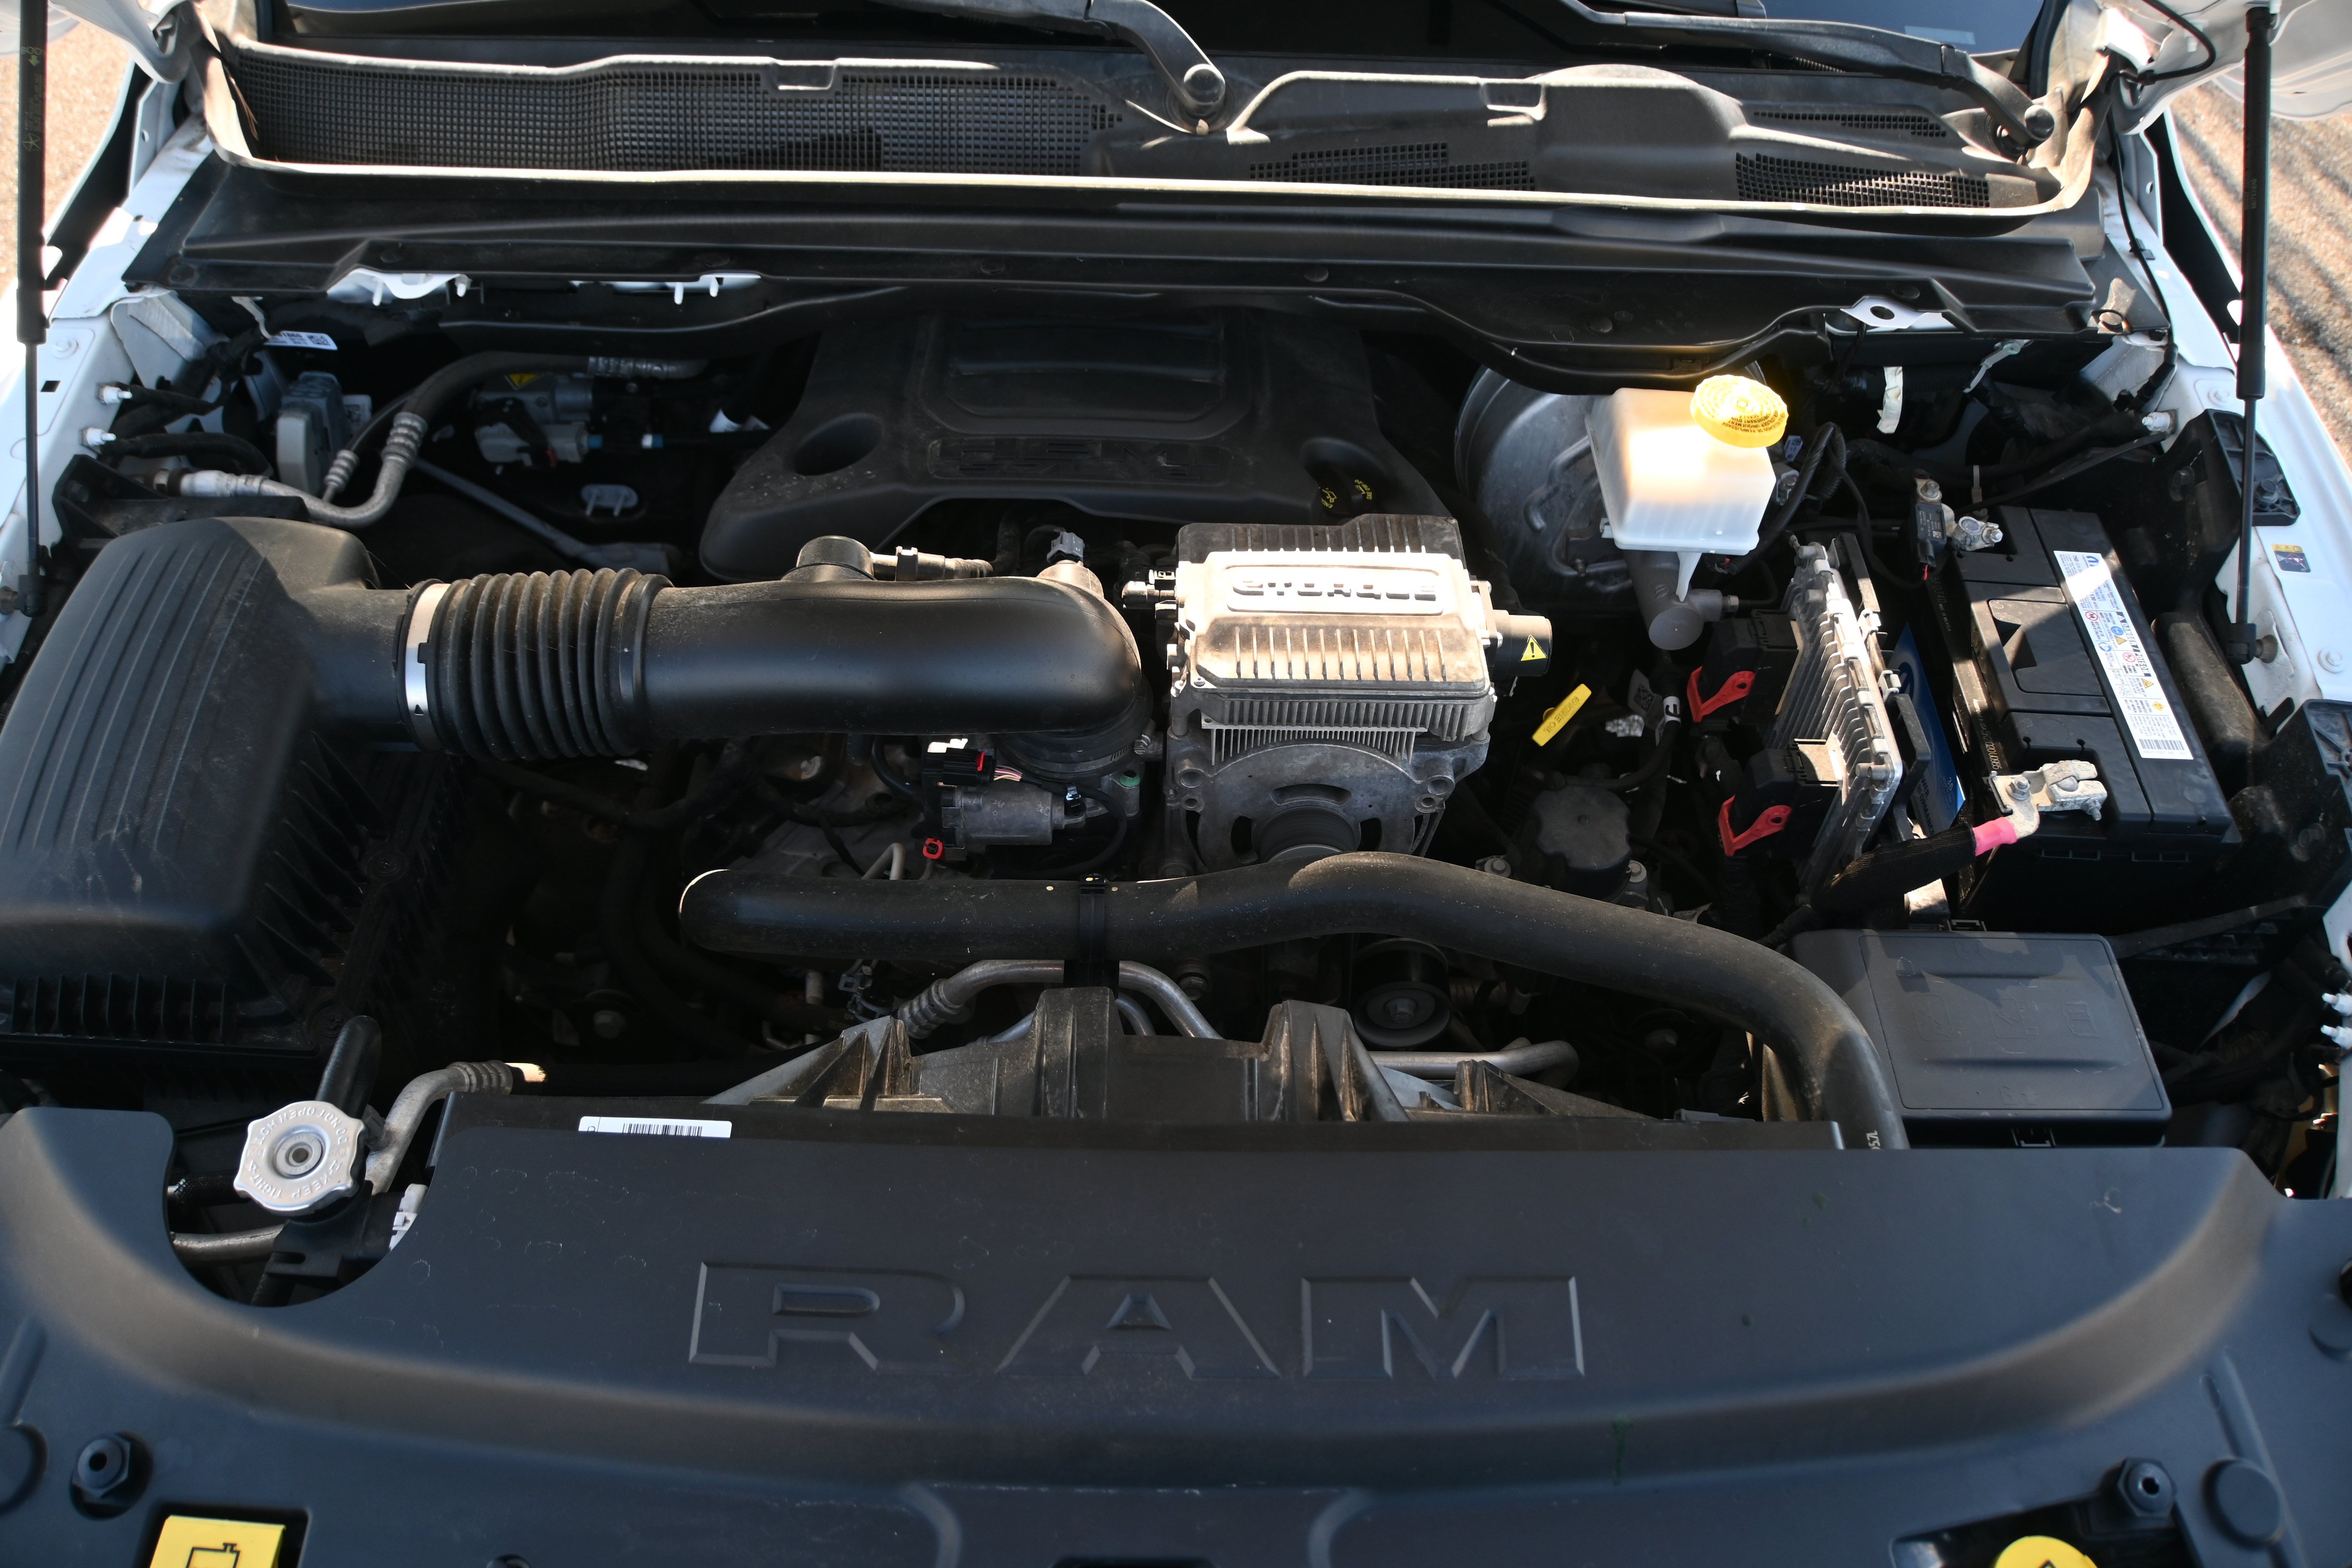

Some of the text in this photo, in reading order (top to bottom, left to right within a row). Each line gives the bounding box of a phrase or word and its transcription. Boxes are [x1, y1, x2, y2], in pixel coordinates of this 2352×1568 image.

[1321, 498, 1334, 509] ENG
[2120, 622, 2137, 645] DANGER
[2133, 651, 2150, 673] POISON
[1544, 695, 1579, 732] ENGINE OIL
[1947, 776, 1953, 791] 36
[278, 1107, 316, 1124] OPEN
[317, 1109, 340, 1129] NOT
[255, 1120, 277, 1145] HOT
[336, 1127, 348, 1145] DO
[250, 1173, 331, 1199] KEEP TIGHT
[690, 1261, 1585, 1380] RAM
